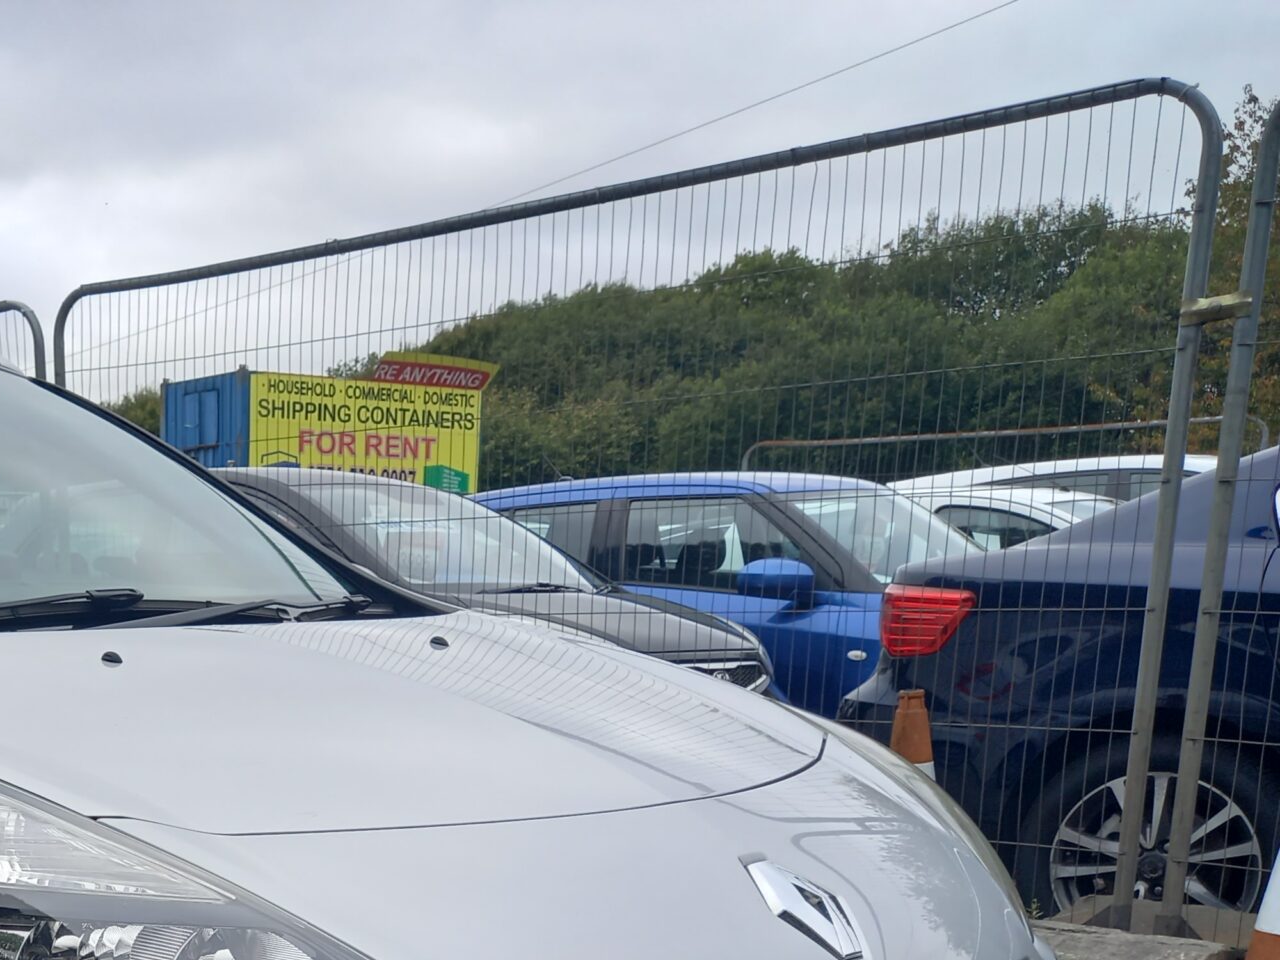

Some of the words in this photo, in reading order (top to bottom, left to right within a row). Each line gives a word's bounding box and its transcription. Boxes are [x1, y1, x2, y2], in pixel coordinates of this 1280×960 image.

[399, 366, 483, 388] ANYTHING
[267, 378, 336, 399] HOUSEHOLD
[345, 385, 415, 405] COMMERCIAL
[423, 391, 476, 409] DOMESTIC
[257, 398, 352, 424] SHIPPING
[357, 405, 476, 431] CONTAINERS
[298, 430, 357, 456] FOR
[365, 434, 437, 460] RENT
